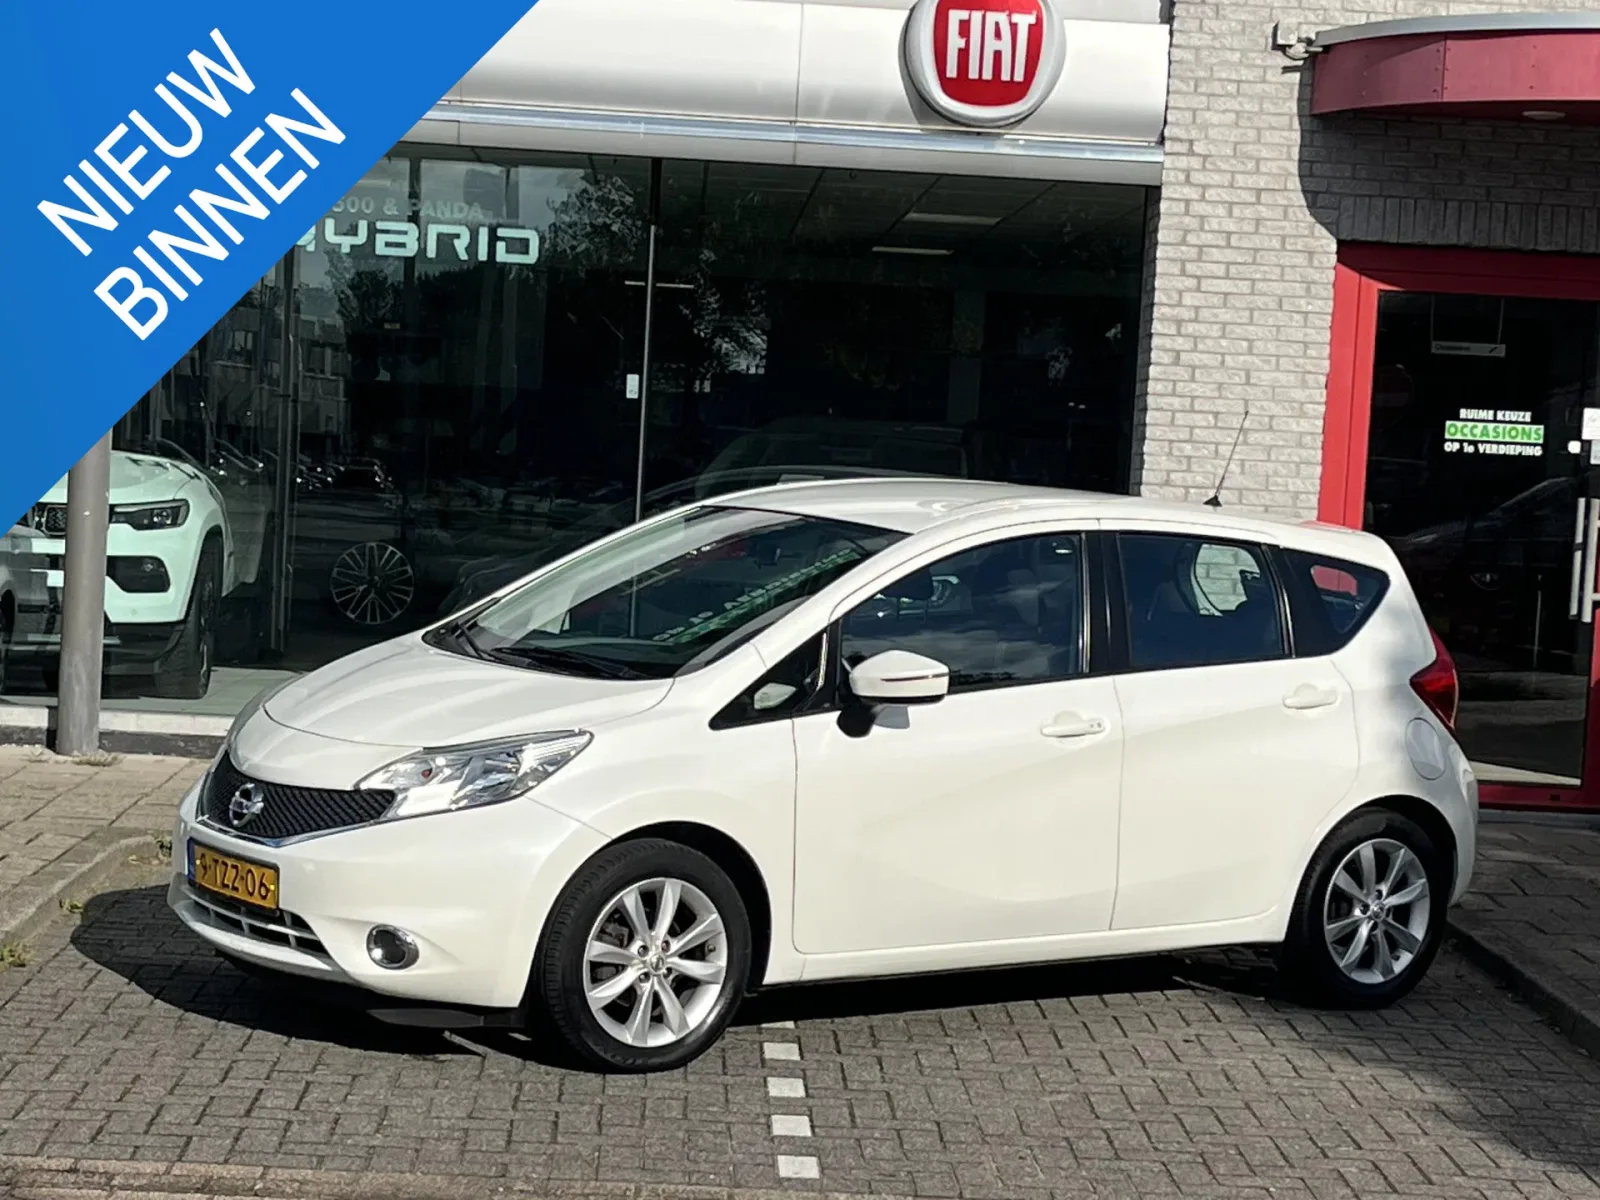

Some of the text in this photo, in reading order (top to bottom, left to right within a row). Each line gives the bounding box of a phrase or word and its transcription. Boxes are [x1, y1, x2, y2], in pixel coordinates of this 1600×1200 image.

[946, 9, 1037, 82] FIAT
[383, 197, 399, 215] &
[1459, 408, 1532, 422] RUIME KEUZE
[1446, 422, 1543, 441] OCCASIONS
[1444, 442, 1460, 452] OP
[1477, 443, 1543, 456] VERDIEPING
[199, 853, 270, 901] 9-TZZ-06
